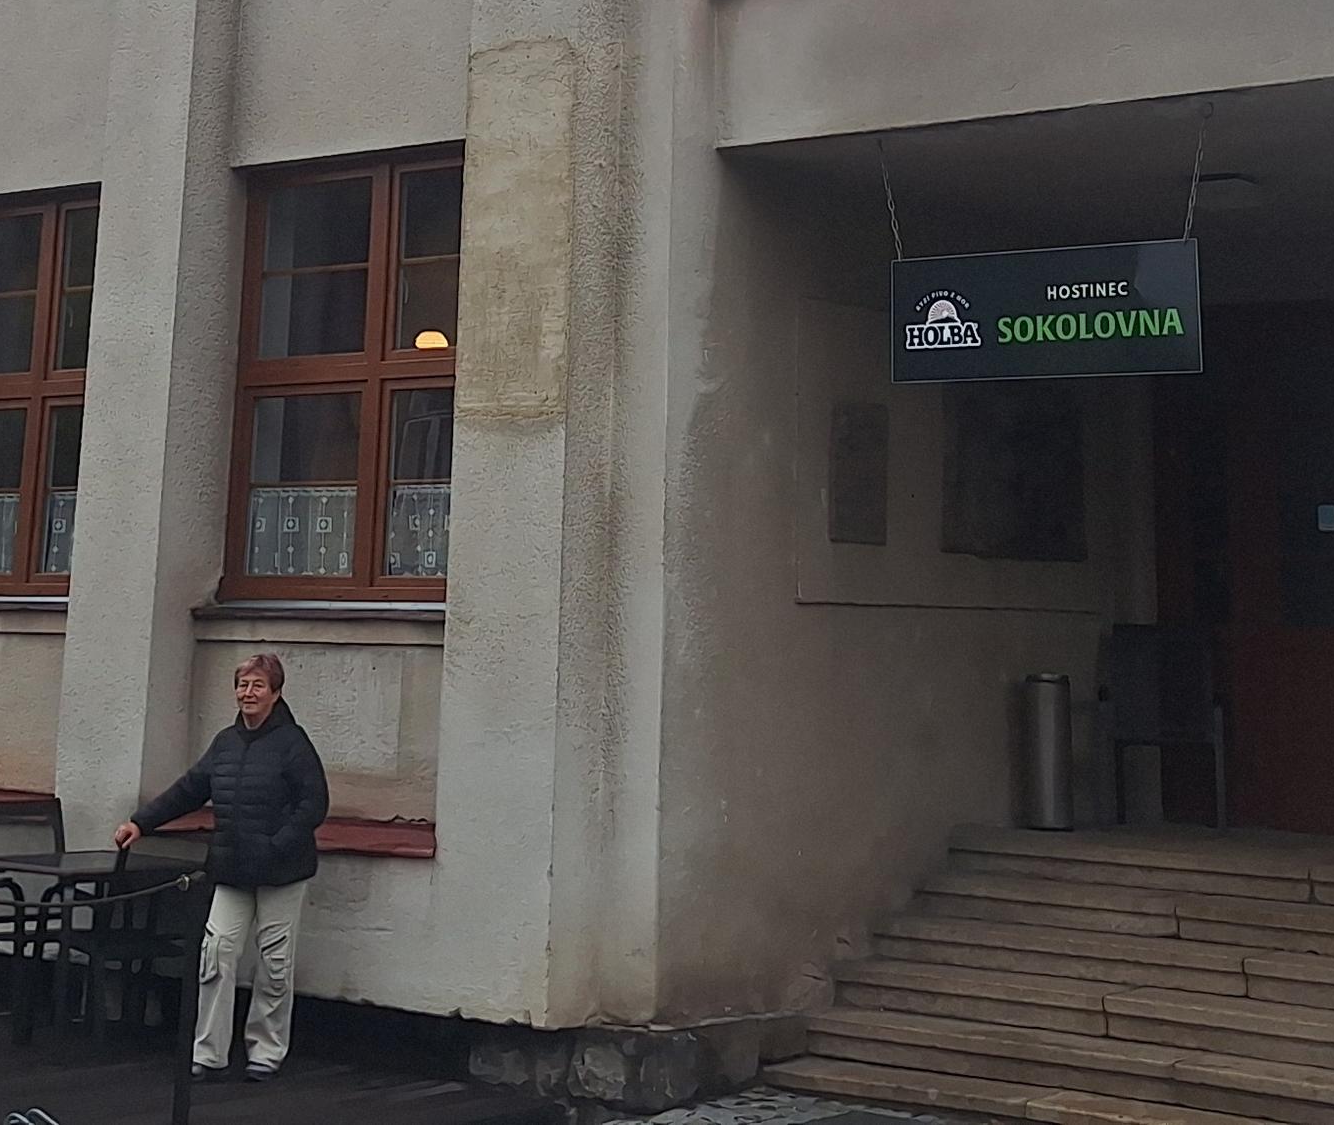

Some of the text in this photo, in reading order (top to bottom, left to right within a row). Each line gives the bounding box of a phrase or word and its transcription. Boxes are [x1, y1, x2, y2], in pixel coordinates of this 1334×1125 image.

[1047, 281, 1129, 300] HOSTINEC
[907, 322, 981, 349] HOLBA
[997, 308, 1184, 344] SOKOLOVNA
